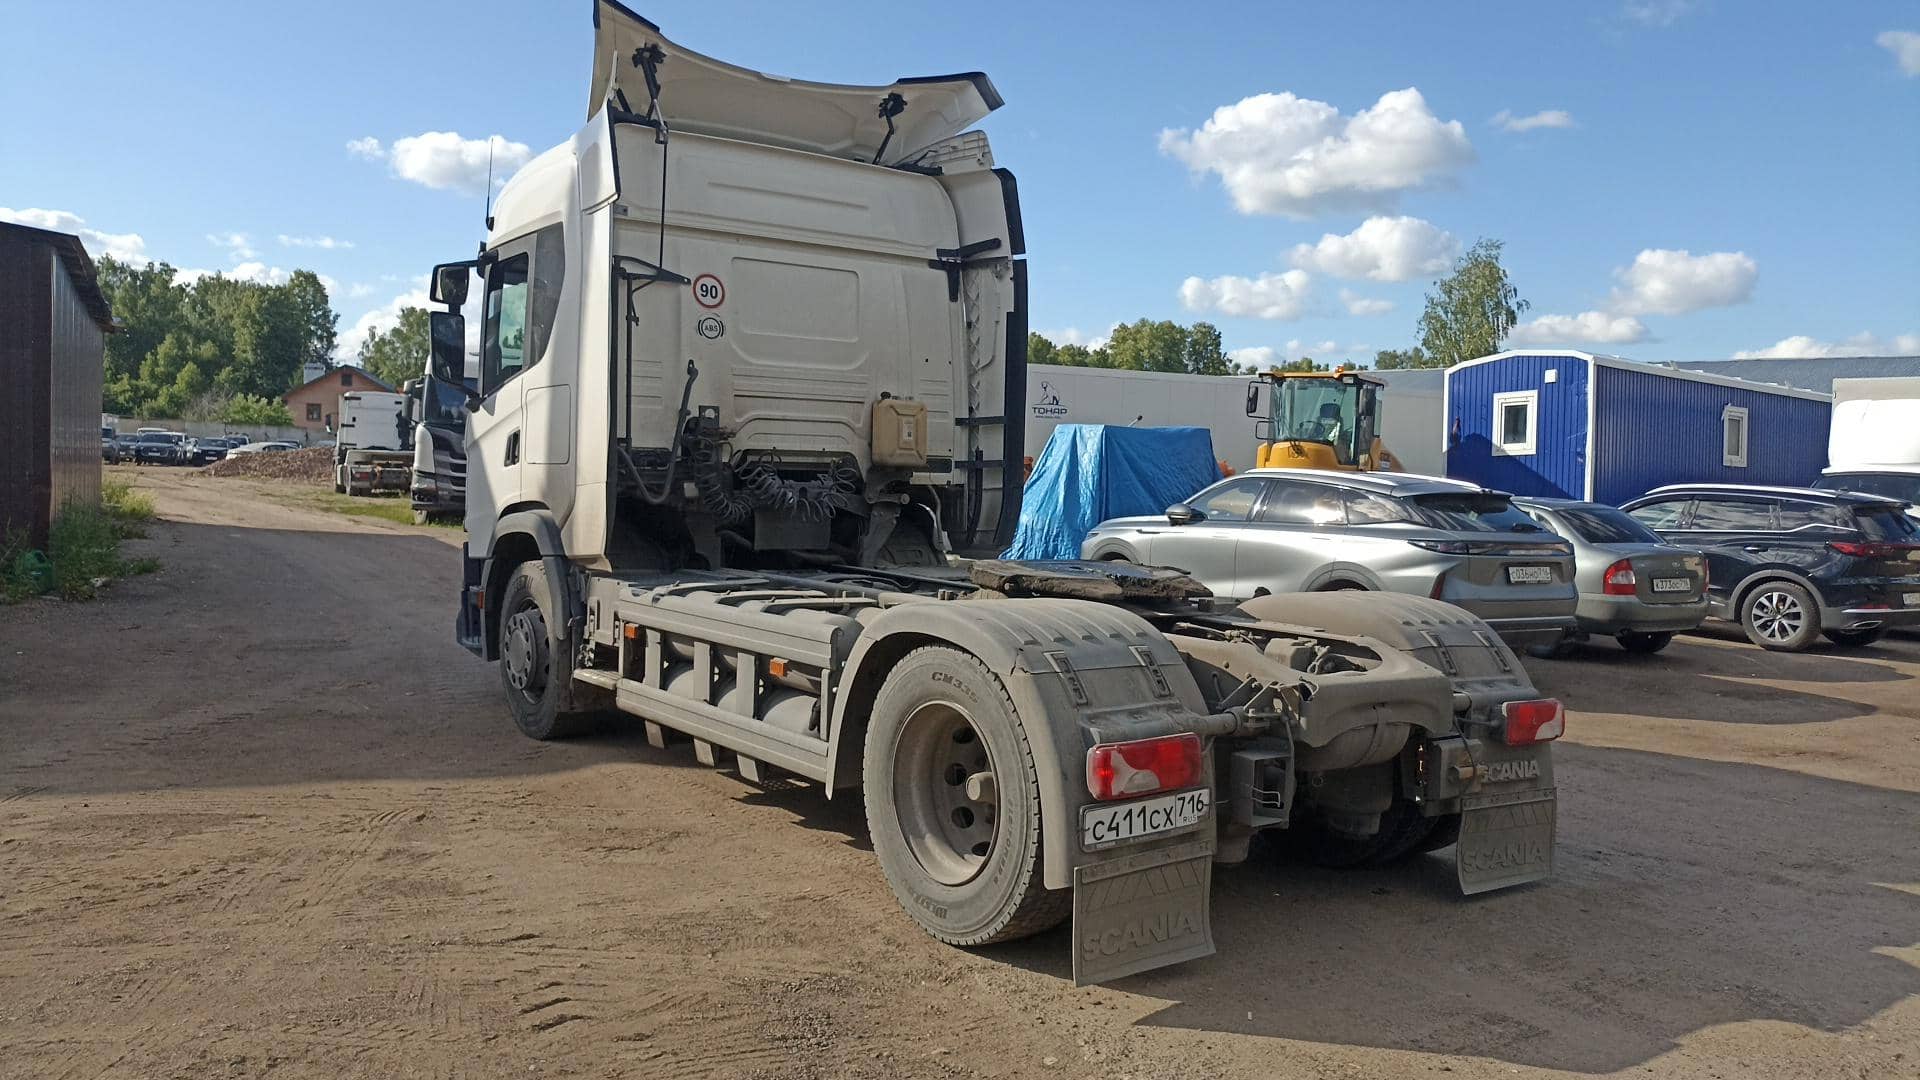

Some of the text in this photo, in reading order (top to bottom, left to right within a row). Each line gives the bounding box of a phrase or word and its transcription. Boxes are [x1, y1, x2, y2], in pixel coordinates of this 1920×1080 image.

[700, 283, 718, 300] 90
[704, 324, 719, 332] ABS
[1032, 406, 1068, 415] ТОНАР
[1092, 792, 1206, 841] С411СХ 716
[1182, 814, 1198, 823] RUS
[1463, 842, 1544, 874] SCANIA
[1081, 910, 1200, 960] SCANIA
